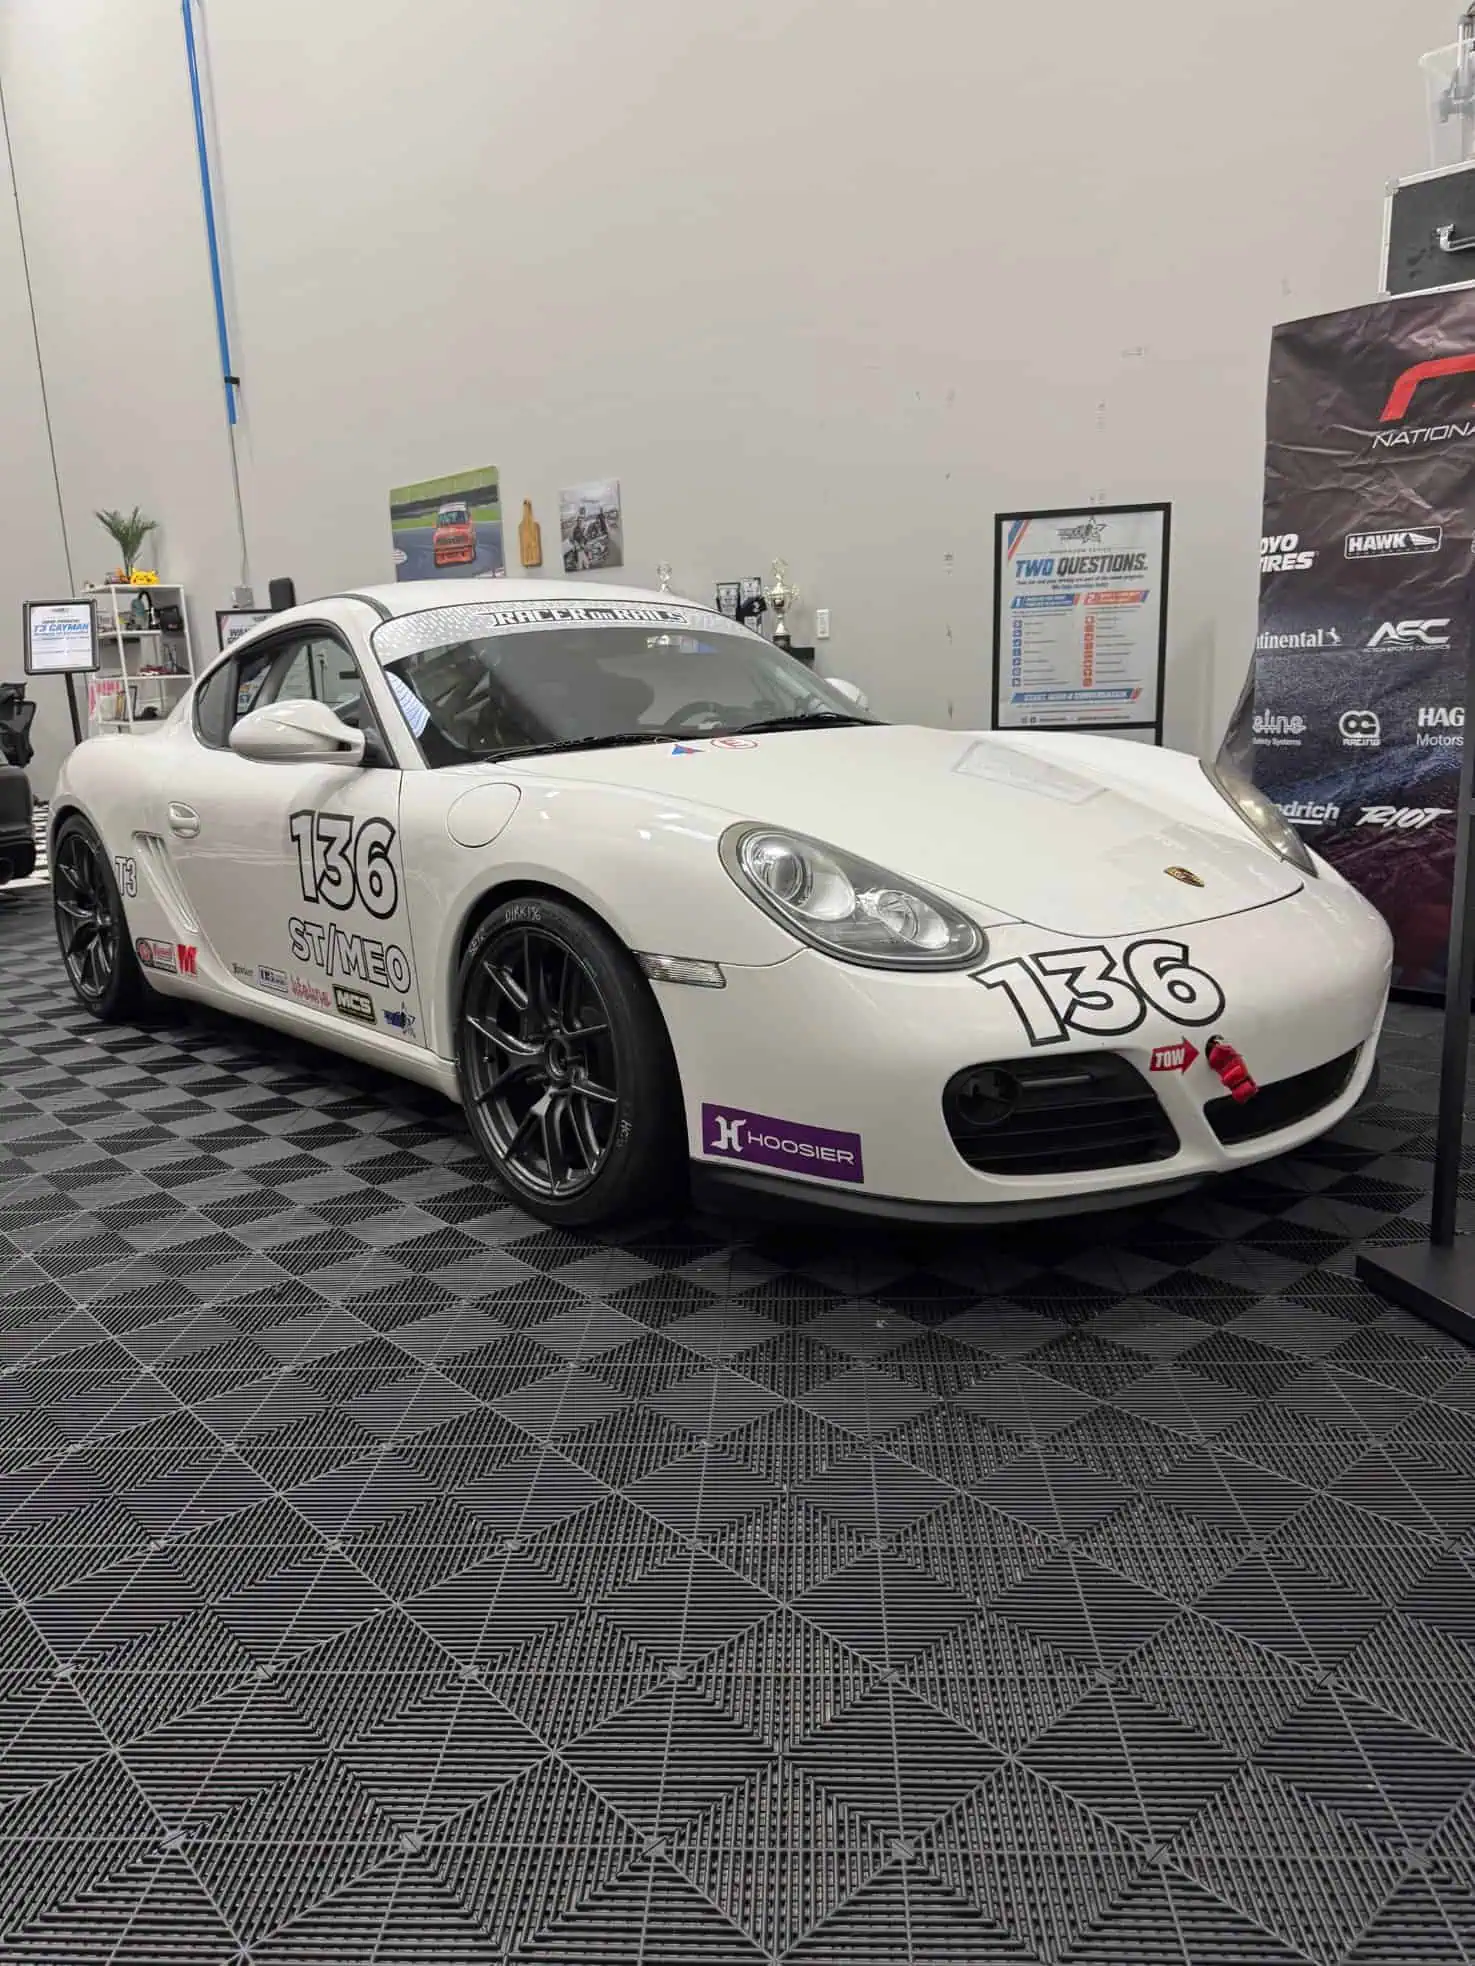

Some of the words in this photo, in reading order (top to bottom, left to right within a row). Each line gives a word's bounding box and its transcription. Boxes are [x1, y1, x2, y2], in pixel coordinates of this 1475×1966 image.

[1349, 533, 1406, 552] HAWK
[1016, 559, 1054, 578] TWO
[1057, 553, 1148, 576] QUESTIONS.
[48, 623, 88, 631] CAYMAN
[494, 609, 588, 626] RACER
[617, 609, 688, 624] RAILS
[1366, 618, 1451, 647] ASC
[1418, 706, 1465, 727] HAG
[1416, 733, 1465, 746] Motors
[1355, 806, 1455, 829] RIOT
[114, 855, 138, 898] T3
[290, 809, 398, 920] 136
[288, 916, 412, 994] ST/MEO
[968, 938, 1226, 1048] 136
[1155, 1047, 1185, 1068] TOW
[747, 1130, 856, 1165] HOOSIER
